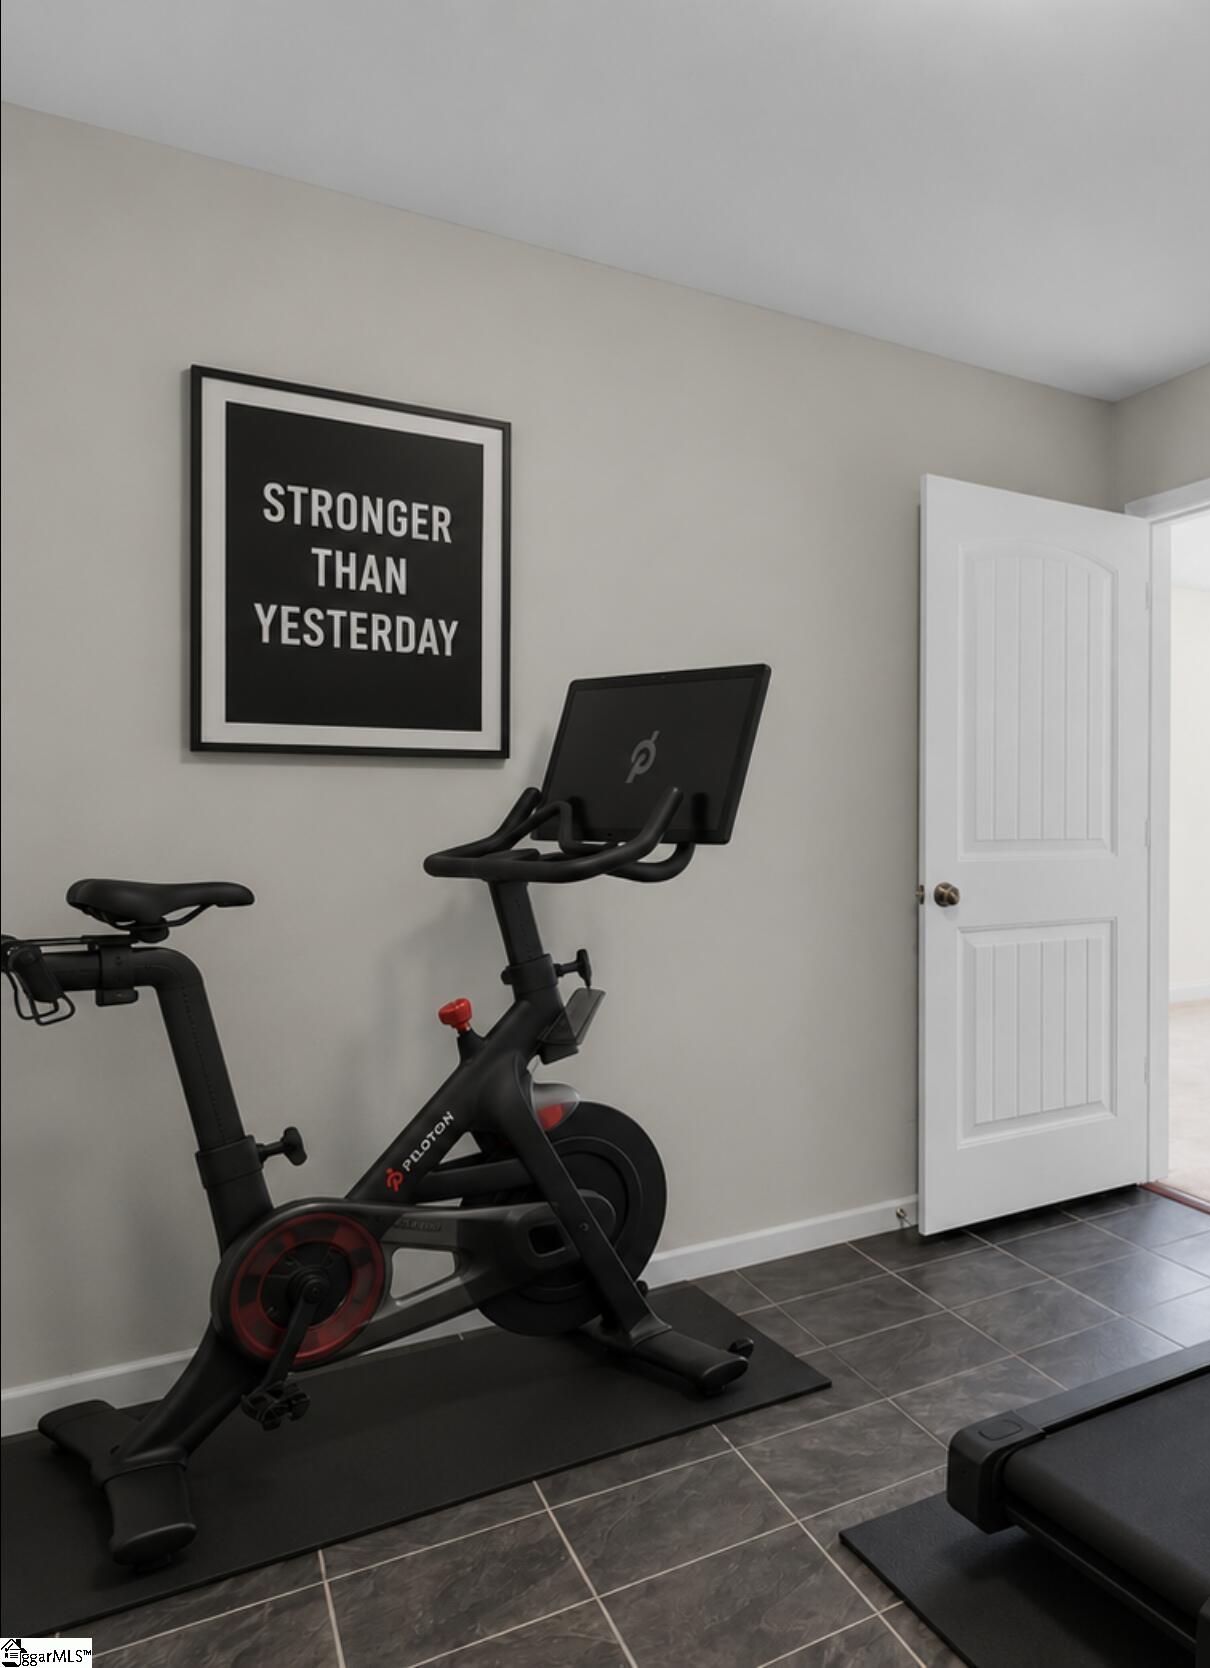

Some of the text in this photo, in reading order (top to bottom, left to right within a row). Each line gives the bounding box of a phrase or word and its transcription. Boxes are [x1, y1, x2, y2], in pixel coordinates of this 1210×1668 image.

[263, 482, 452, 543] STRONGER
[311, 546, 407, 595] THAN
[254, 602, 459, 656] YESTERDAY
